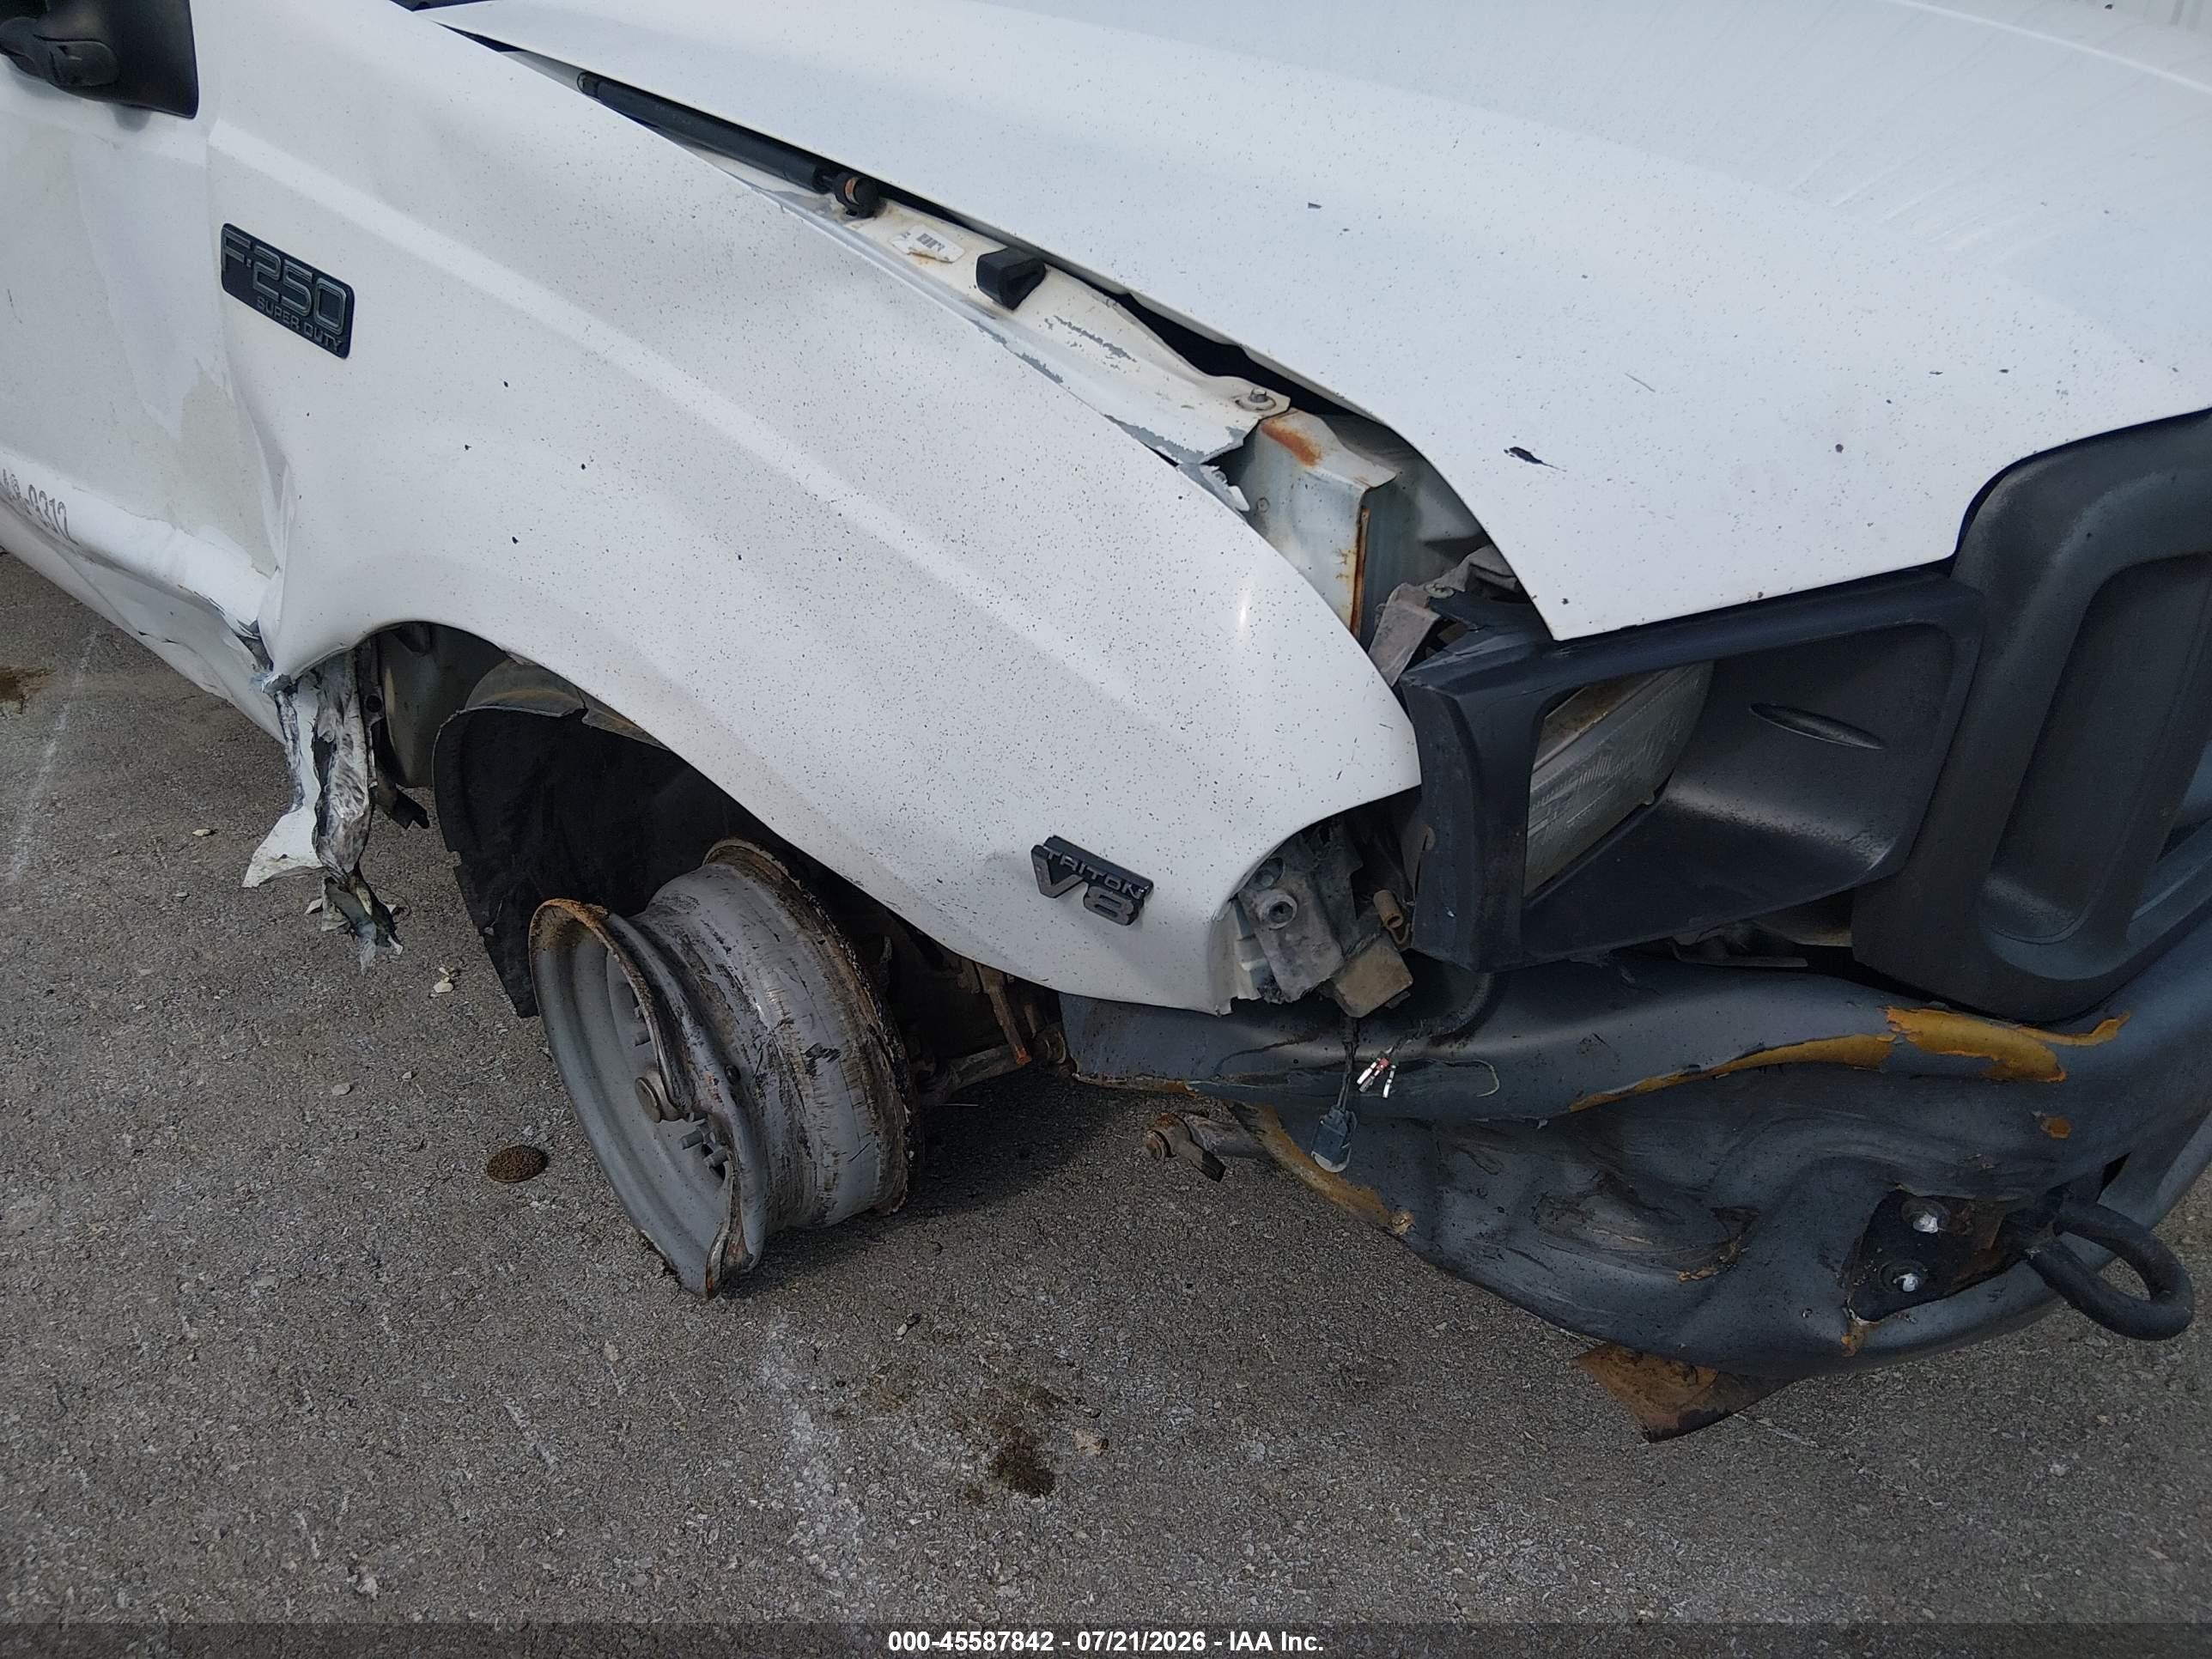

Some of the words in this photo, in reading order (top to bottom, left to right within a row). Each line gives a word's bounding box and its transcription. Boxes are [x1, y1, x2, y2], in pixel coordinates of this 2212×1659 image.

[222, 228, 346, 335] F-250
[257, 296, 300, 330] SUPER
[304, 322, 343, 352] DUTY
[1031, 845, 1140, 926] V8
[1043, 846, 1146, 900] TRITON
